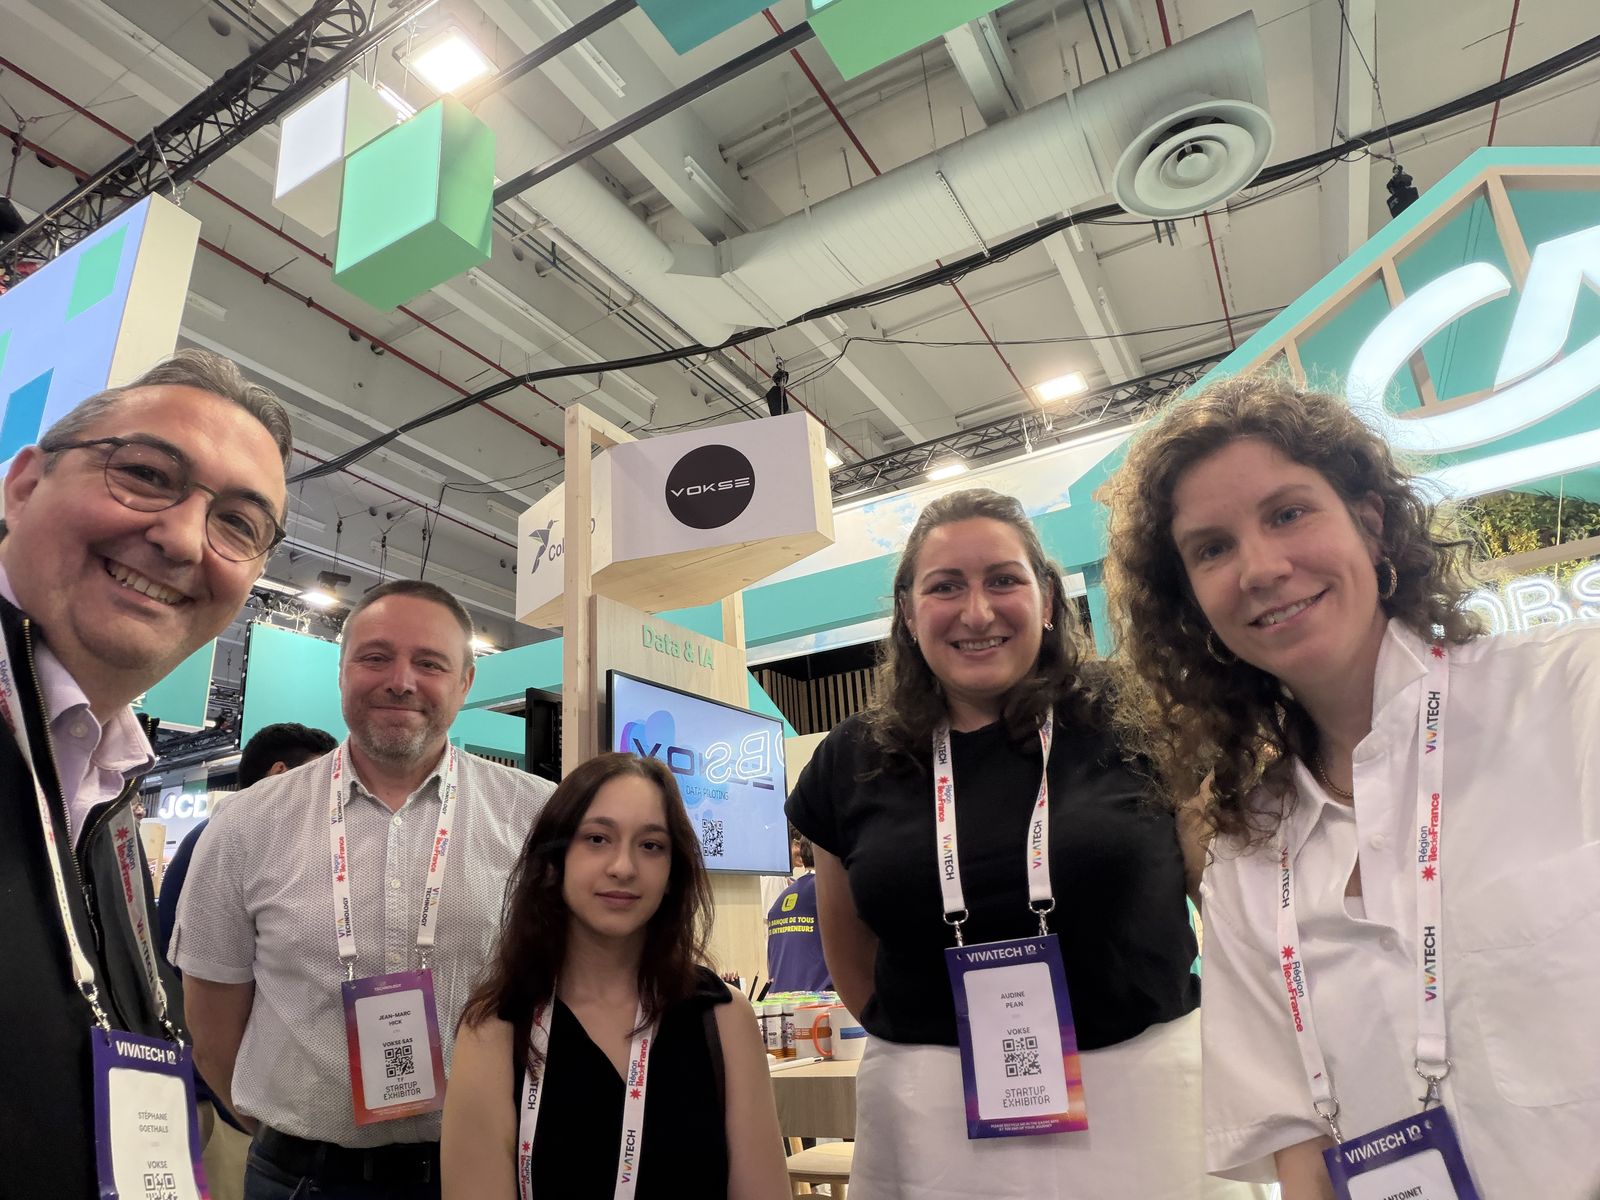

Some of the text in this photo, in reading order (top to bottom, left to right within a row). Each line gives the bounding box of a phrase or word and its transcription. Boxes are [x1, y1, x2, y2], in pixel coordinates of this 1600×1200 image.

[670, 477, 750, 497] VOKSE
[642, 624, 714, 670] Data & IA
[1425, 691, 1441, 755] VIVATECH
[686, 785, 701, 796] DATA
[126, 837, 135, 871] Région
[1032, 820, 1043, 870] VIVATECH
[1419, 825, 1430, 863] Région
[943, 834, 955, 881] VIVATECH
[430, 887, 440, 906] VIVA
[343, 897, 352, 936] TECHNOLOGY
[421, 887, 432, 927] TECHNOLOGY
[337, 917, 345, 938] VIVA
[798, 916, 814, 924] TOUS
[967, 947, 1022, 963] VIVATECH
[1424, 926, 1436, 1002] VIVATECH
[1292, 961, 1305, 998] Région
[1001, 991, 1025, 999] AUDINE
[379, 1011, 411, 1020] JEAN-MARC
[1007, 1027, 1031, 1036] VOKSE
[116, 1041, 165, 1063] VIVATECH
[628, 1059, 638, 1087] Région
[384, 1088, 421, 1100] EXHIBITOR
[386, 1081, 417, 1093] STARTUP
[1005, 1086, 1046, 1098] STARTUP
[1003, 1095, 1050, 1108] EXHIBITOR
[139, 1125, 168, 1133] GOETHALS
[621, 1129, 636, 1184] VIVATECH
[1345, 1131, 1407, 1164] VIVATECH
[147, 1160, 168, 1168] VOKSE
[1384, 1186, 1422, 1200] NTOINET
